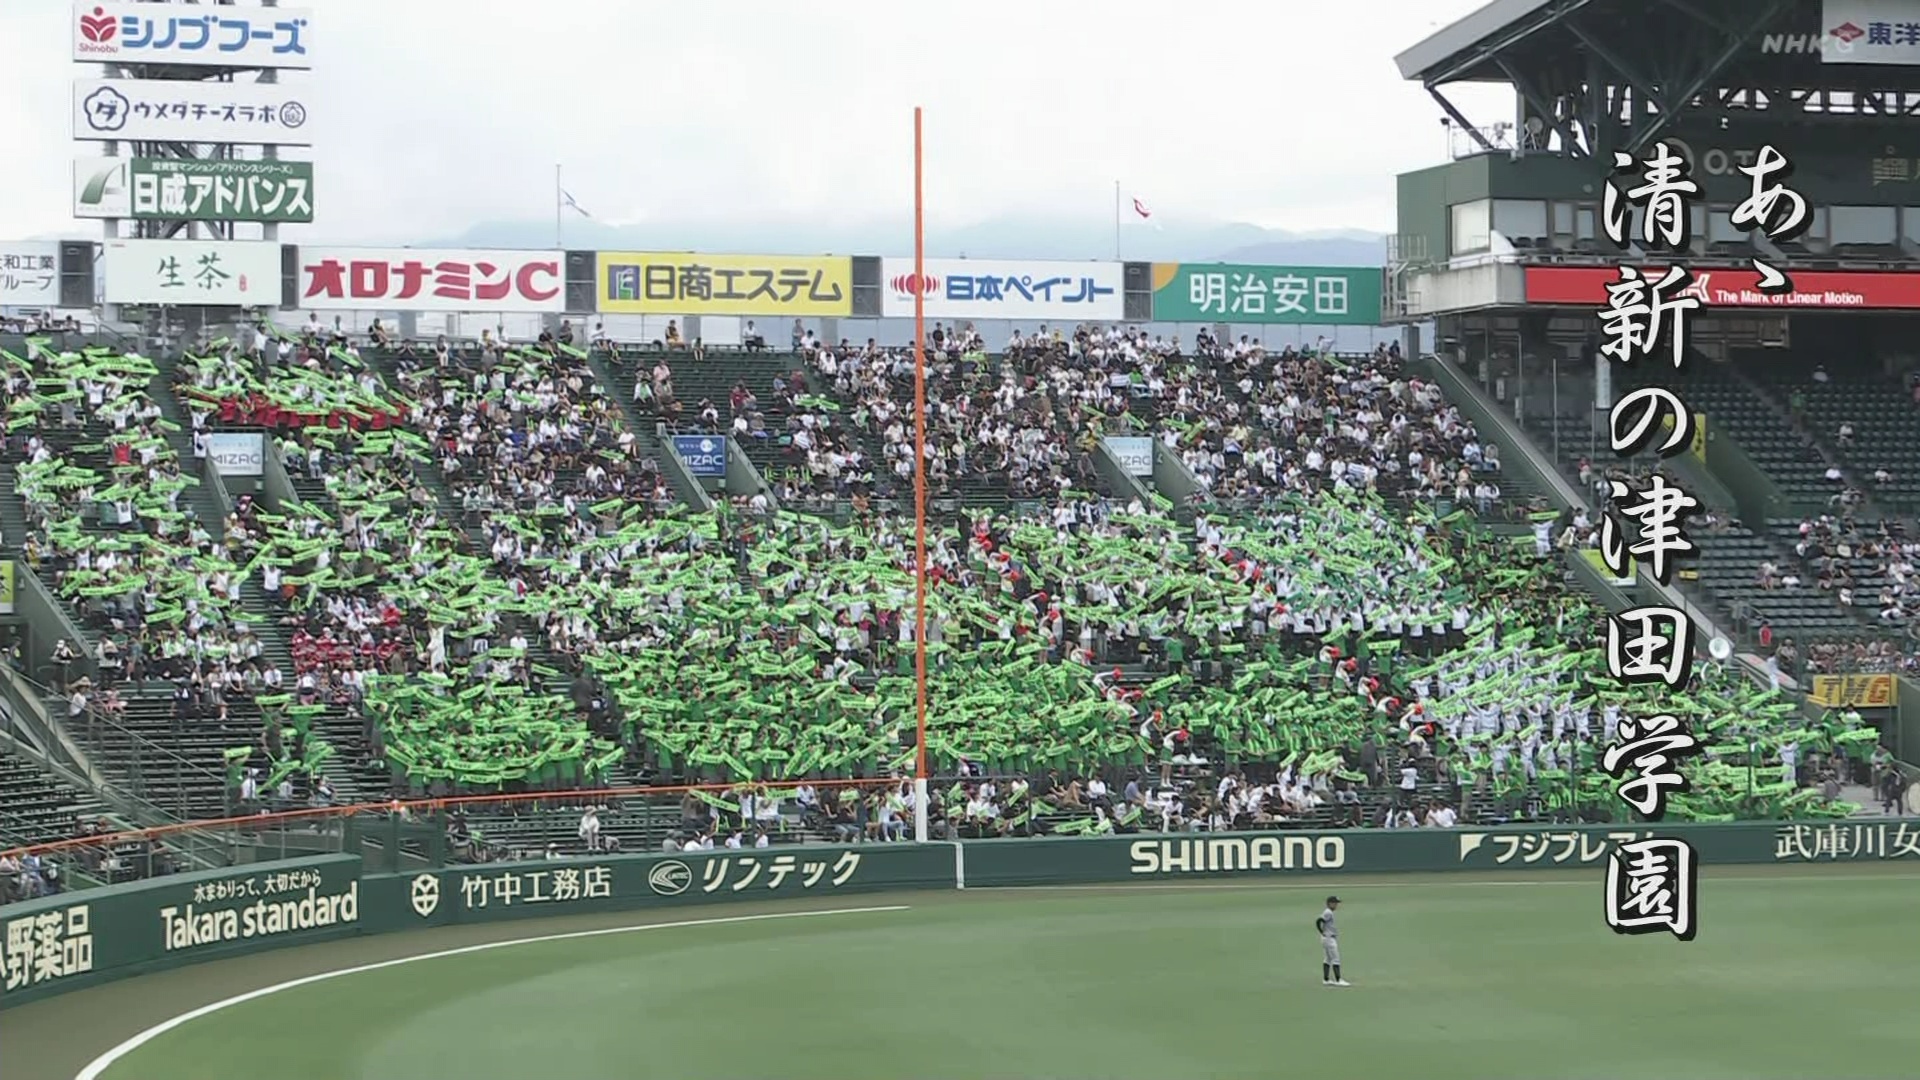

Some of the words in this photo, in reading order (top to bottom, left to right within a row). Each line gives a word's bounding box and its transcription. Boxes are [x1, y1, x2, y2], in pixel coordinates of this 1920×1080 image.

[78, 42, 119, 54] Shinobu
[121, 15, 308, 54] シノブフーズ
[1868, 22, 1920, 45] 東洋
[134, 100, 278, 123] ウメダチーズラボ
[134, 173, 311, 216] 日成アドバンス
[0, 254, 55, 271] 和工業
[156, 251, 231, 290] 生茶
[304, 260, 560, 301] オロナミンC
[0, 273, 55, 291] ループ
[645, 264, 843, 303] 日商エステム
[945, 273, 1115, 304] 日本ペイント
[1189, 272, 1349, 315] 明治安田
[1715, 289, 1739, 304] The
[1787, 291, 1823, 305] Linear
[1825, 291, 1864, 305] Motion
[1119, 455, 1151, 467] IZAC
[1130, 836, 1345, 873] SHIMANO
[1774, 822, 1920, 859] 武庫川女
[193, 869, 322, 904] 水まわりって、大切だから
[460, 866, 612, 909] 竹中工務店
[703, 851, 862, 892] リンテック
[160, 904, 238, 950] Takara
[242, 881, 358, 938] standard
[0, 905, 93, 990] 野薬品
